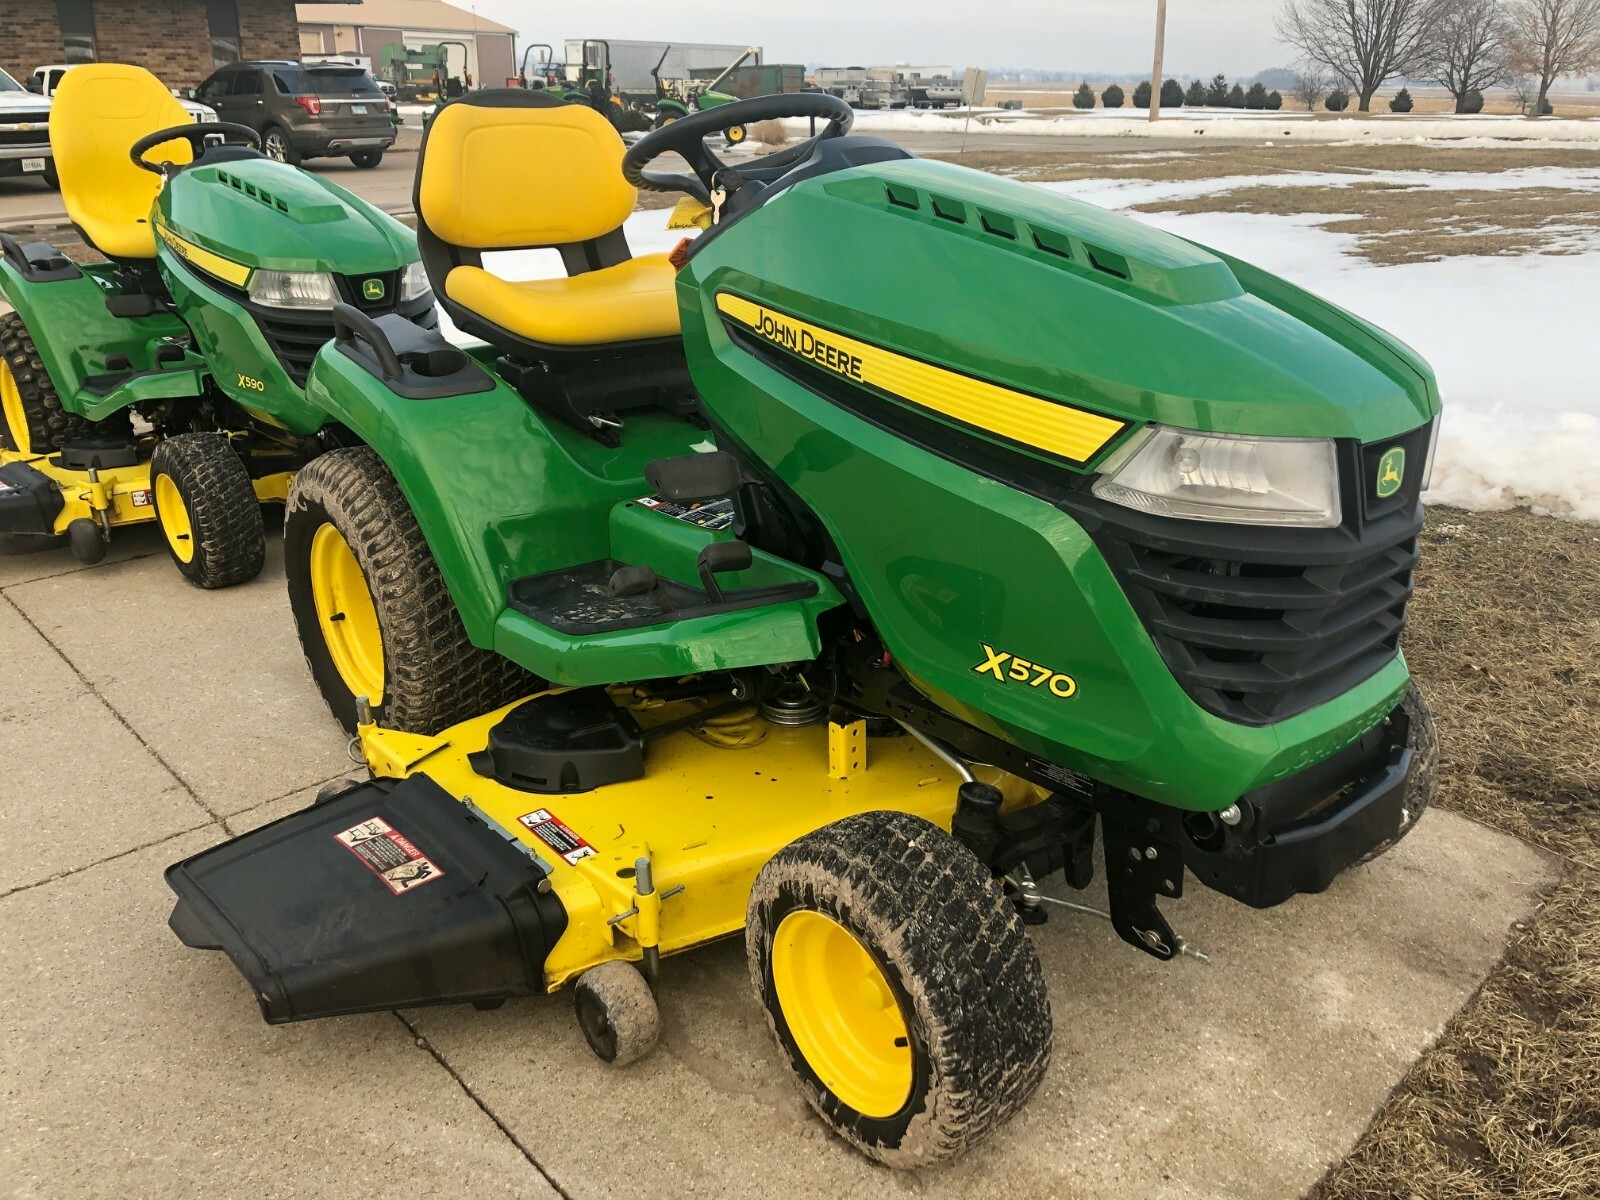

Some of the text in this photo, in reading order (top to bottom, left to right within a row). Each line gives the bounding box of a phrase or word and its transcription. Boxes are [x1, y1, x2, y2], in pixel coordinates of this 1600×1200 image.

[173, 237, 189, 258] DEERE
[754, 309, 863, 379] JOHN DEERE
[237, 372, 265, 393] X590
[971, 641, 1077, 698] X570
[395, 837, 421, 857] DANGER
